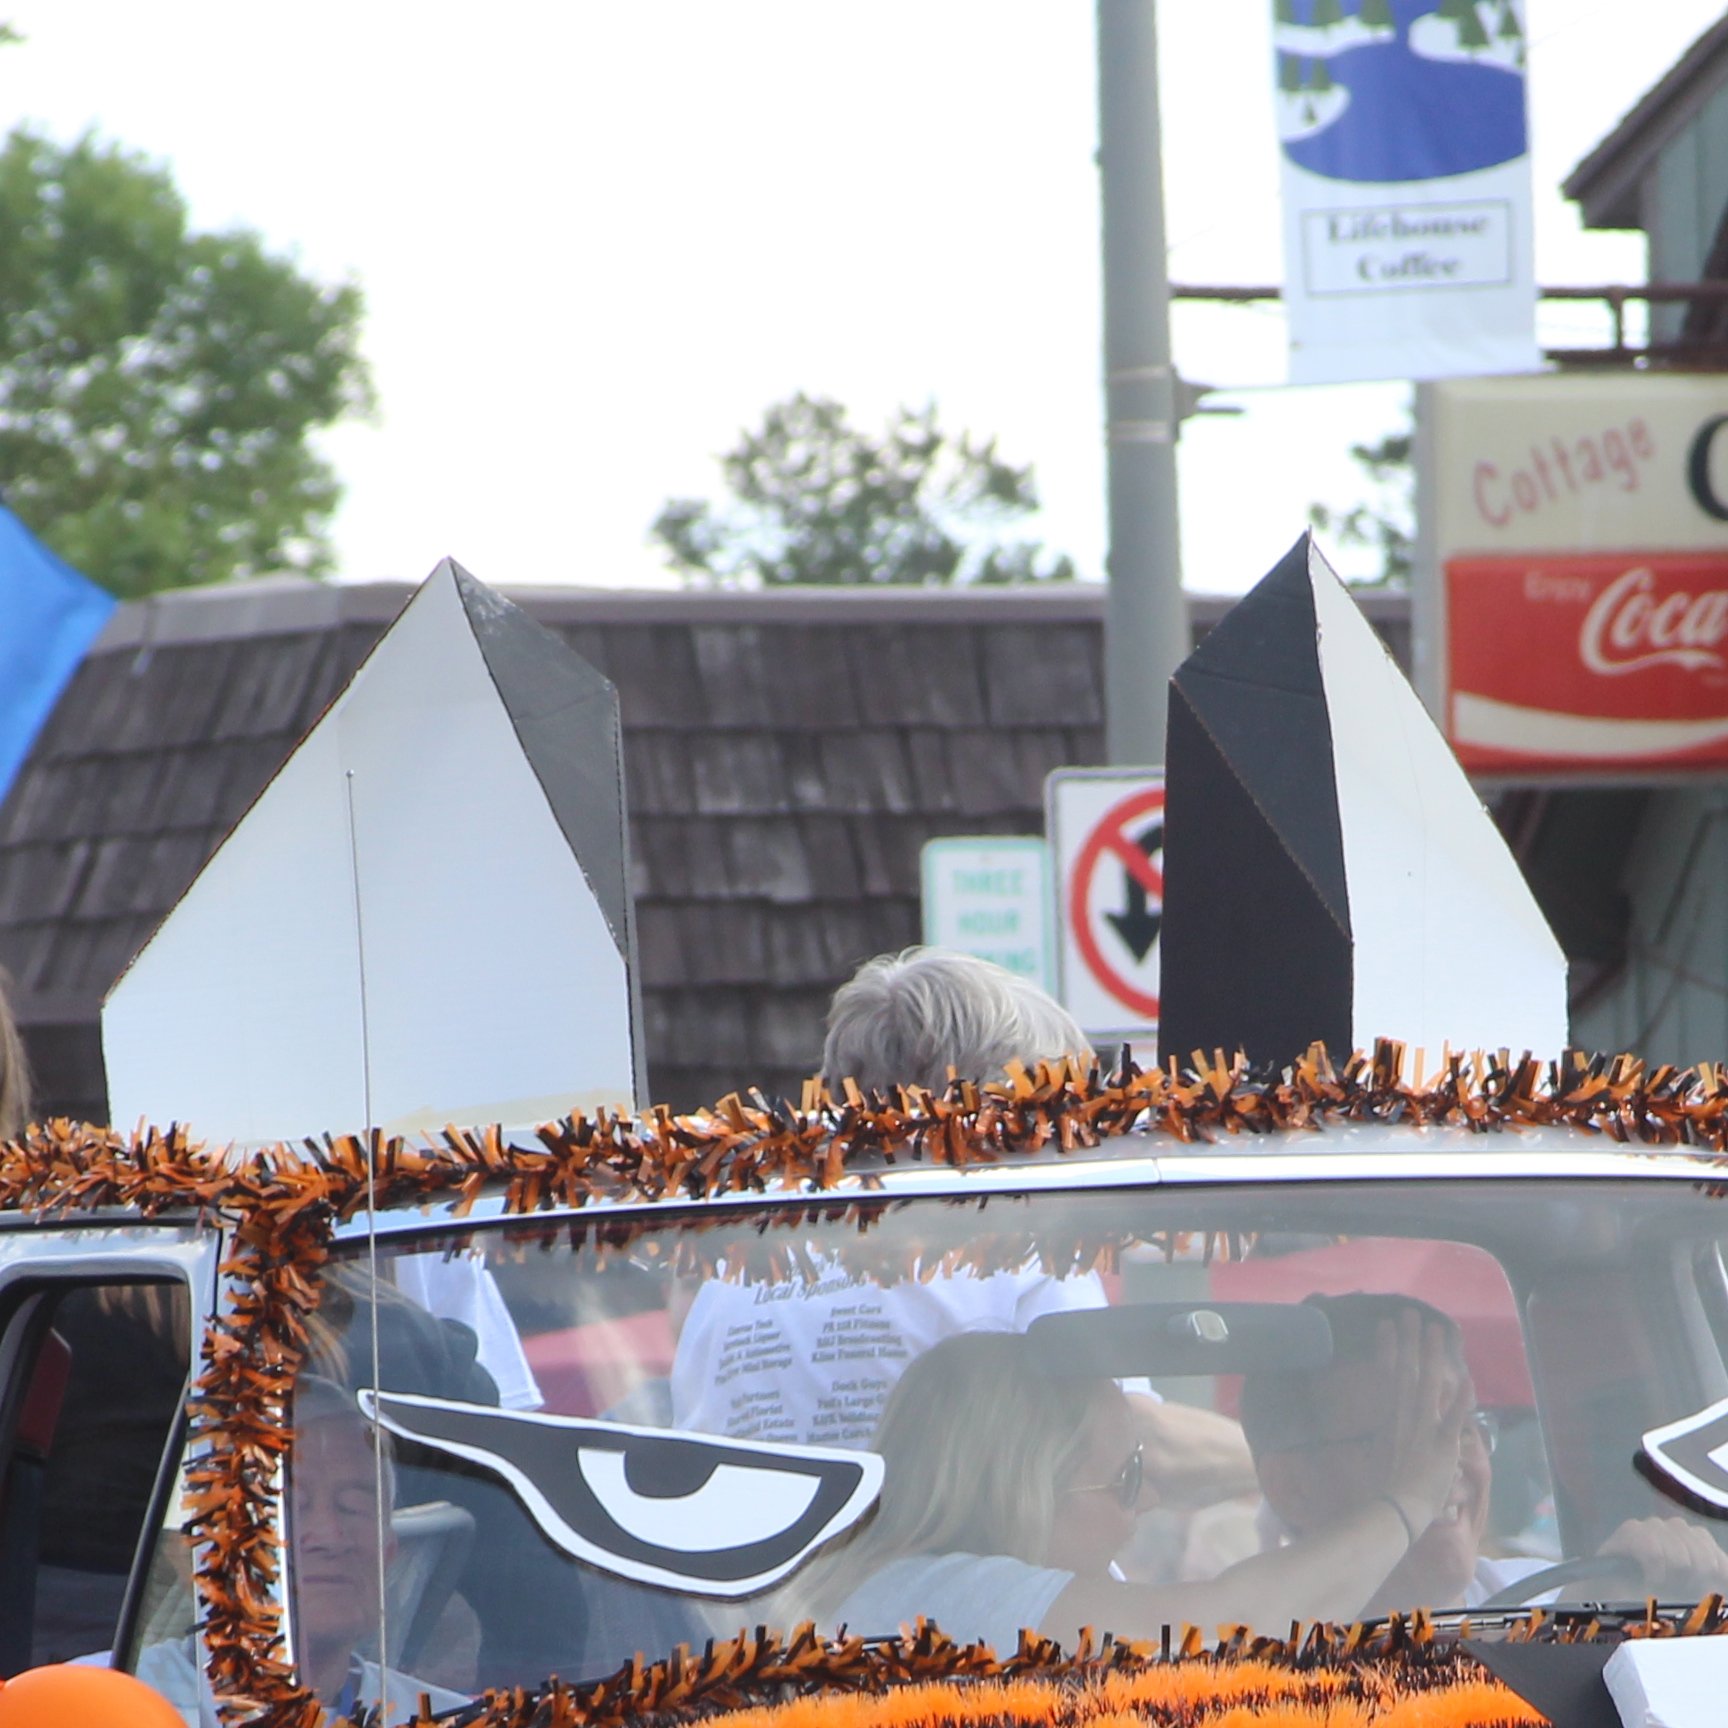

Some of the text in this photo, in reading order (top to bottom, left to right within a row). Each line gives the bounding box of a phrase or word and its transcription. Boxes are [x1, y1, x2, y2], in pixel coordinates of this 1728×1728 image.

[1327, 211, 1490, 243] Lifehouse
[1357, 250, 1460, 281] Coffee
[1475, 418, 1656, 529] Cottage
[952, 869, 1023, 897] THREE
[957, 909, 1019, 935] HOUR
